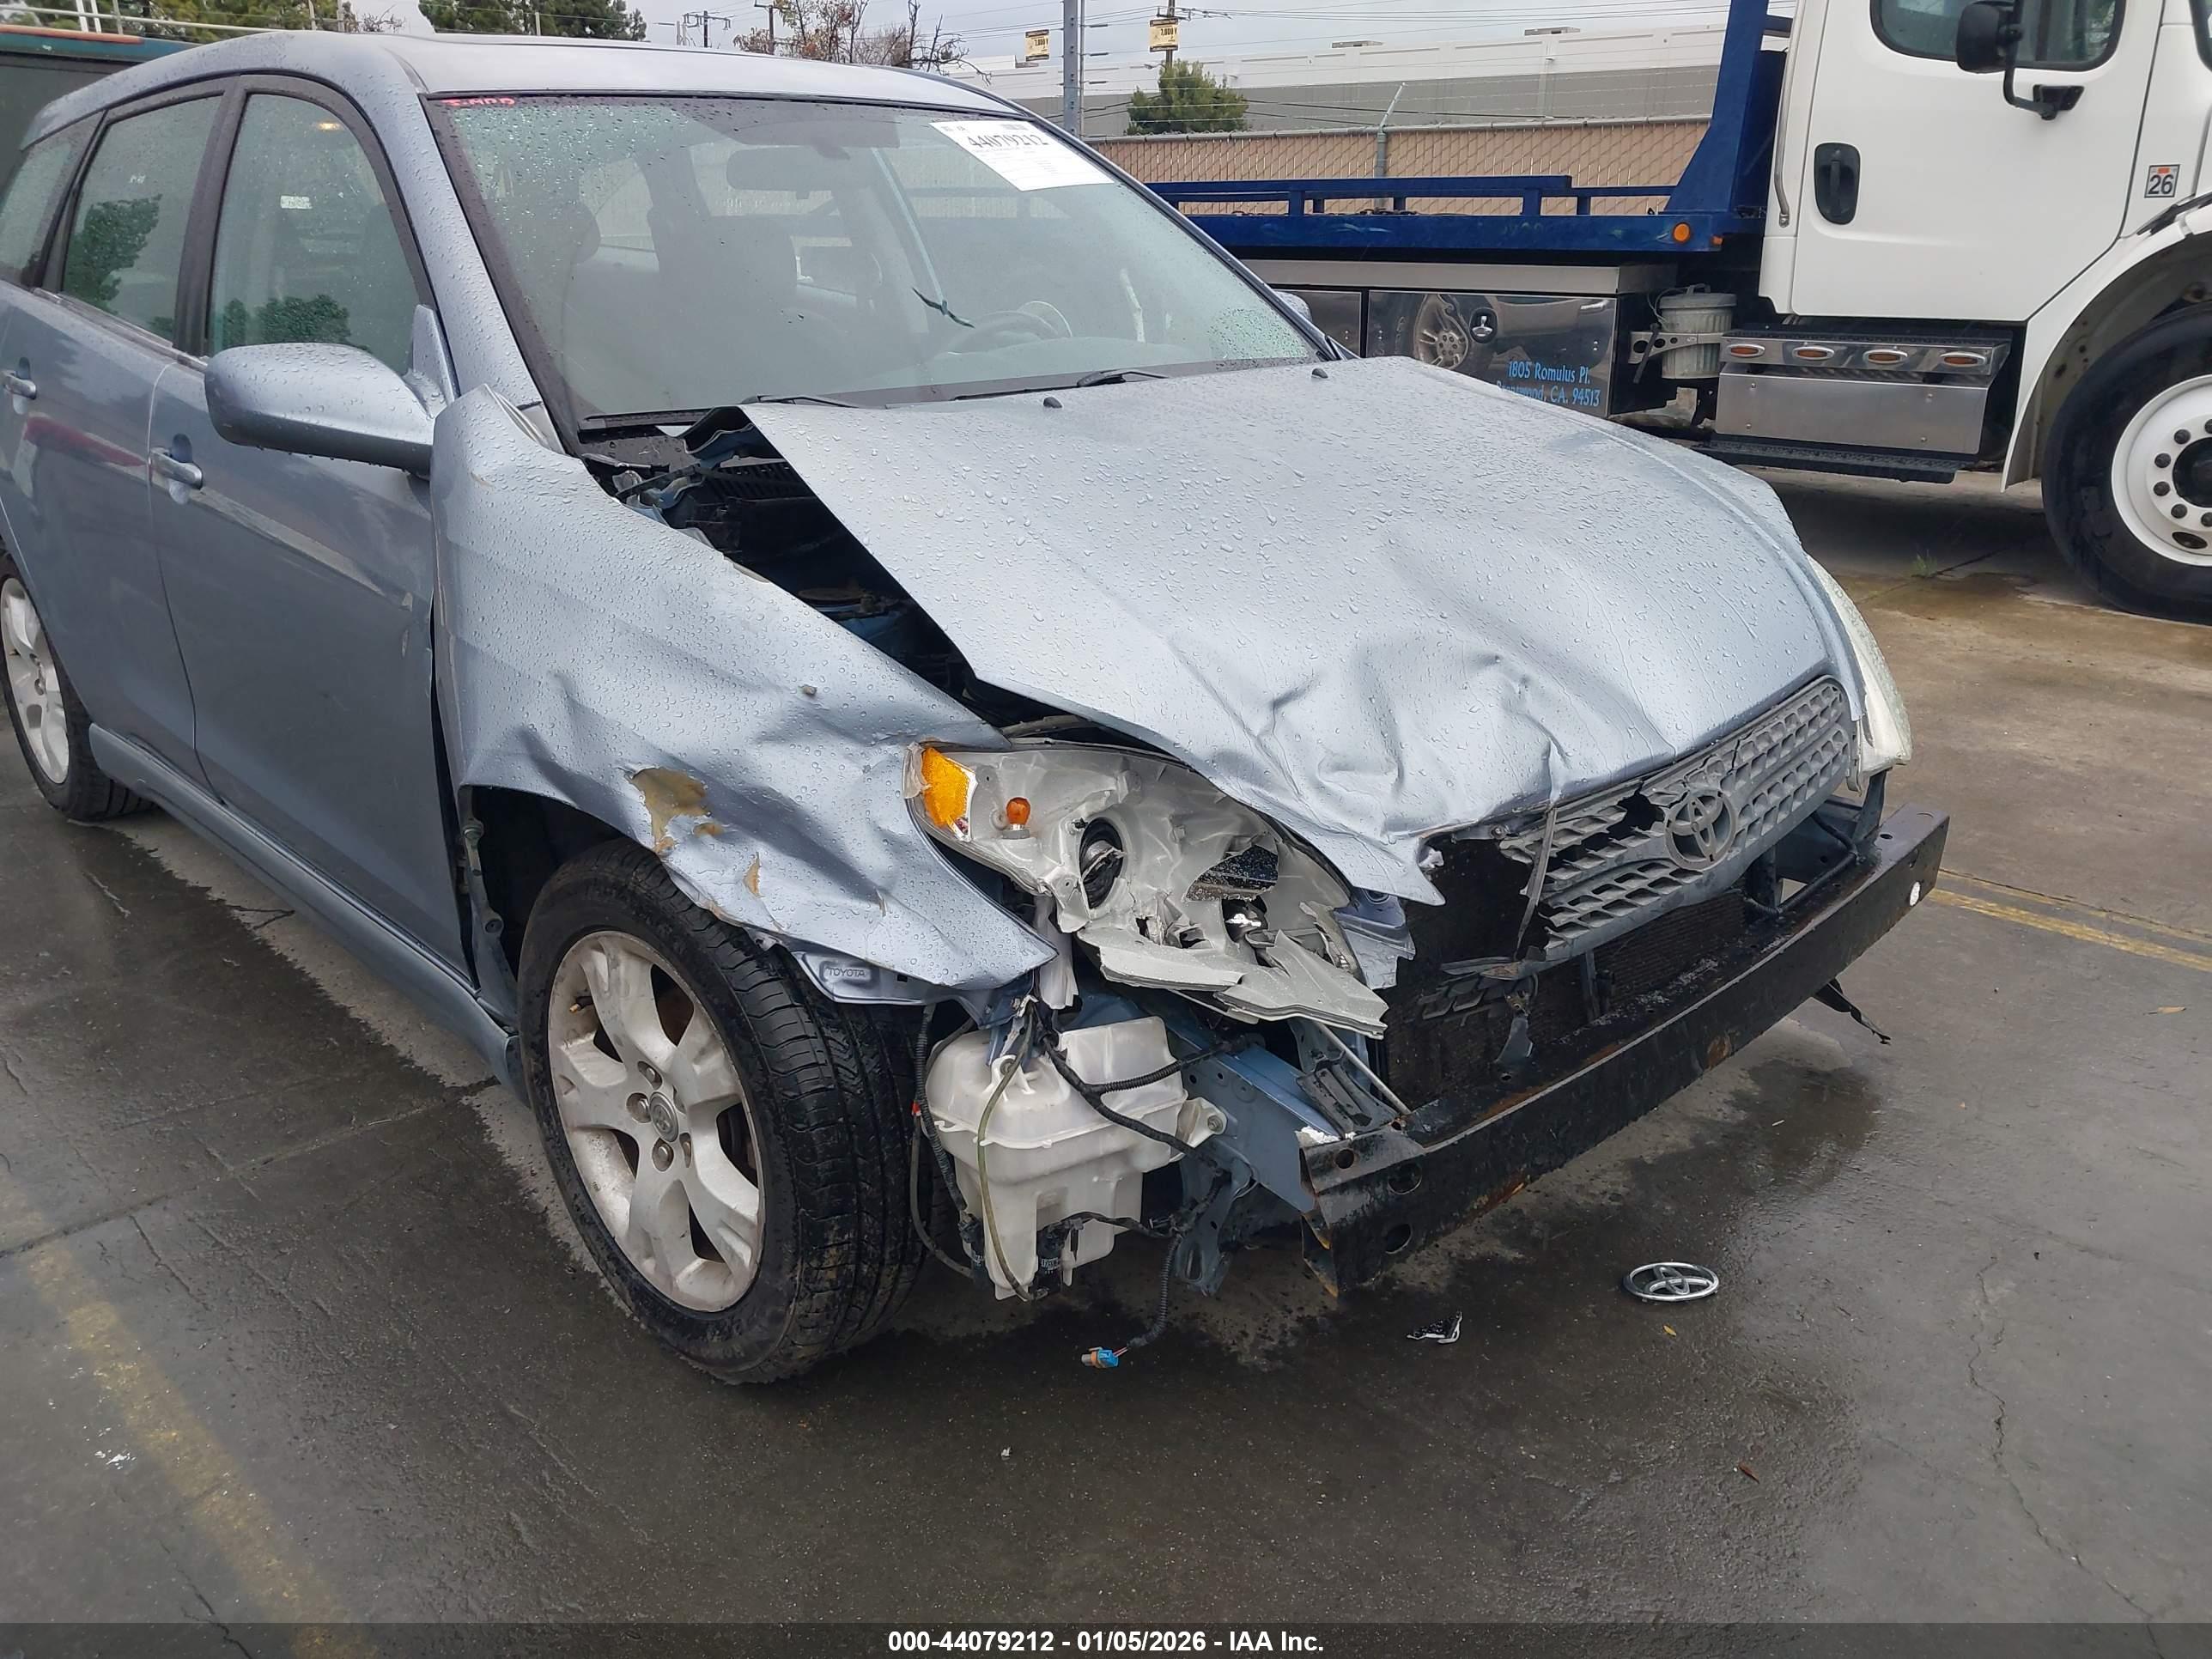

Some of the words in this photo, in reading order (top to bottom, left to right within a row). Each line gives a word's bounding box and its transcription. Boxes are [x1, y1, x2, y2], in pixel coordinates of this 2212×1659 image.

[967, 134, 1049, 148] 44079212
[2148, 173, 2175, 195] 26
[1509, 361, 1532, 379] 1805
[1534, 362, 1576, 383] Romulus
[1578, 366, 1590, 385] Pl.
[1571, 387, 1601, 407] 94513
[826, 966, 866, 977] TOYOTA
